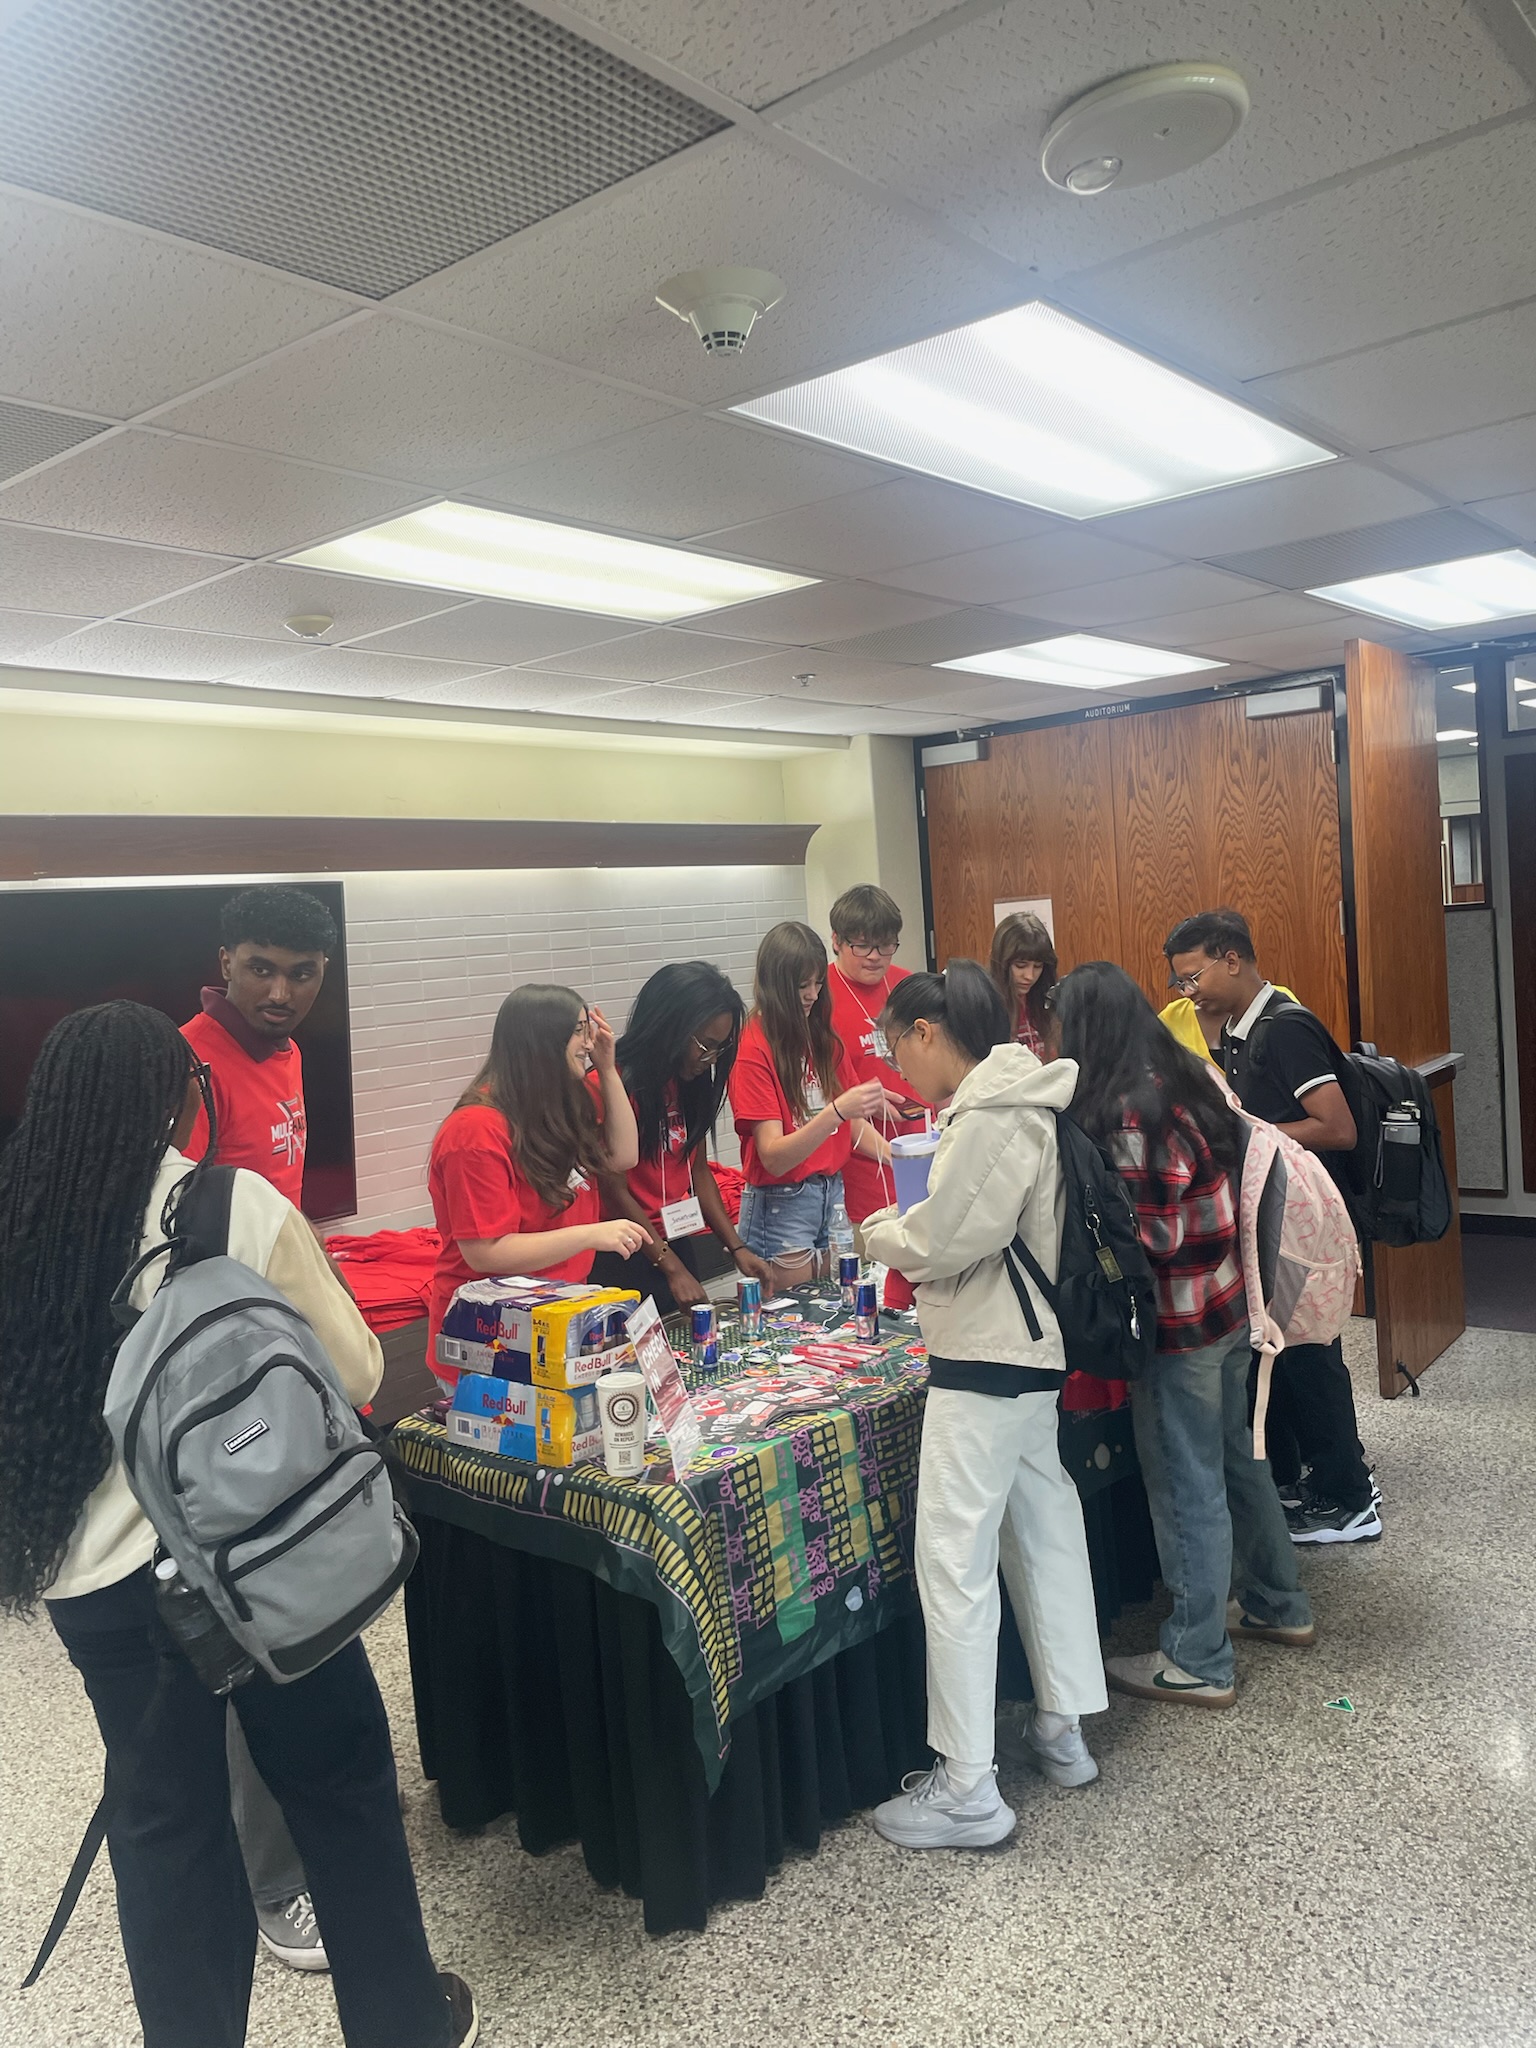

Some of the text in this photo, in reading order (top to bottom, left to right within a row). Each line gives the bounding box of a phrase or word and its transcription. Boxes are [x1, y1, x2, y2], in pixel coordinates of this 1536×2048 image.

[1084, 703, 1131, 719] AUDITORIUM
[476, 1317, 518, 1340] Red Bull
[641, 1328, 668, 1370] CHECK
[574, 1357, 594, 1373] Red
[649, 1368, 663, 1394] IN
[482, 1393, 526, 1416] Red Bull
[571, 1436, 587, 1453] Red
